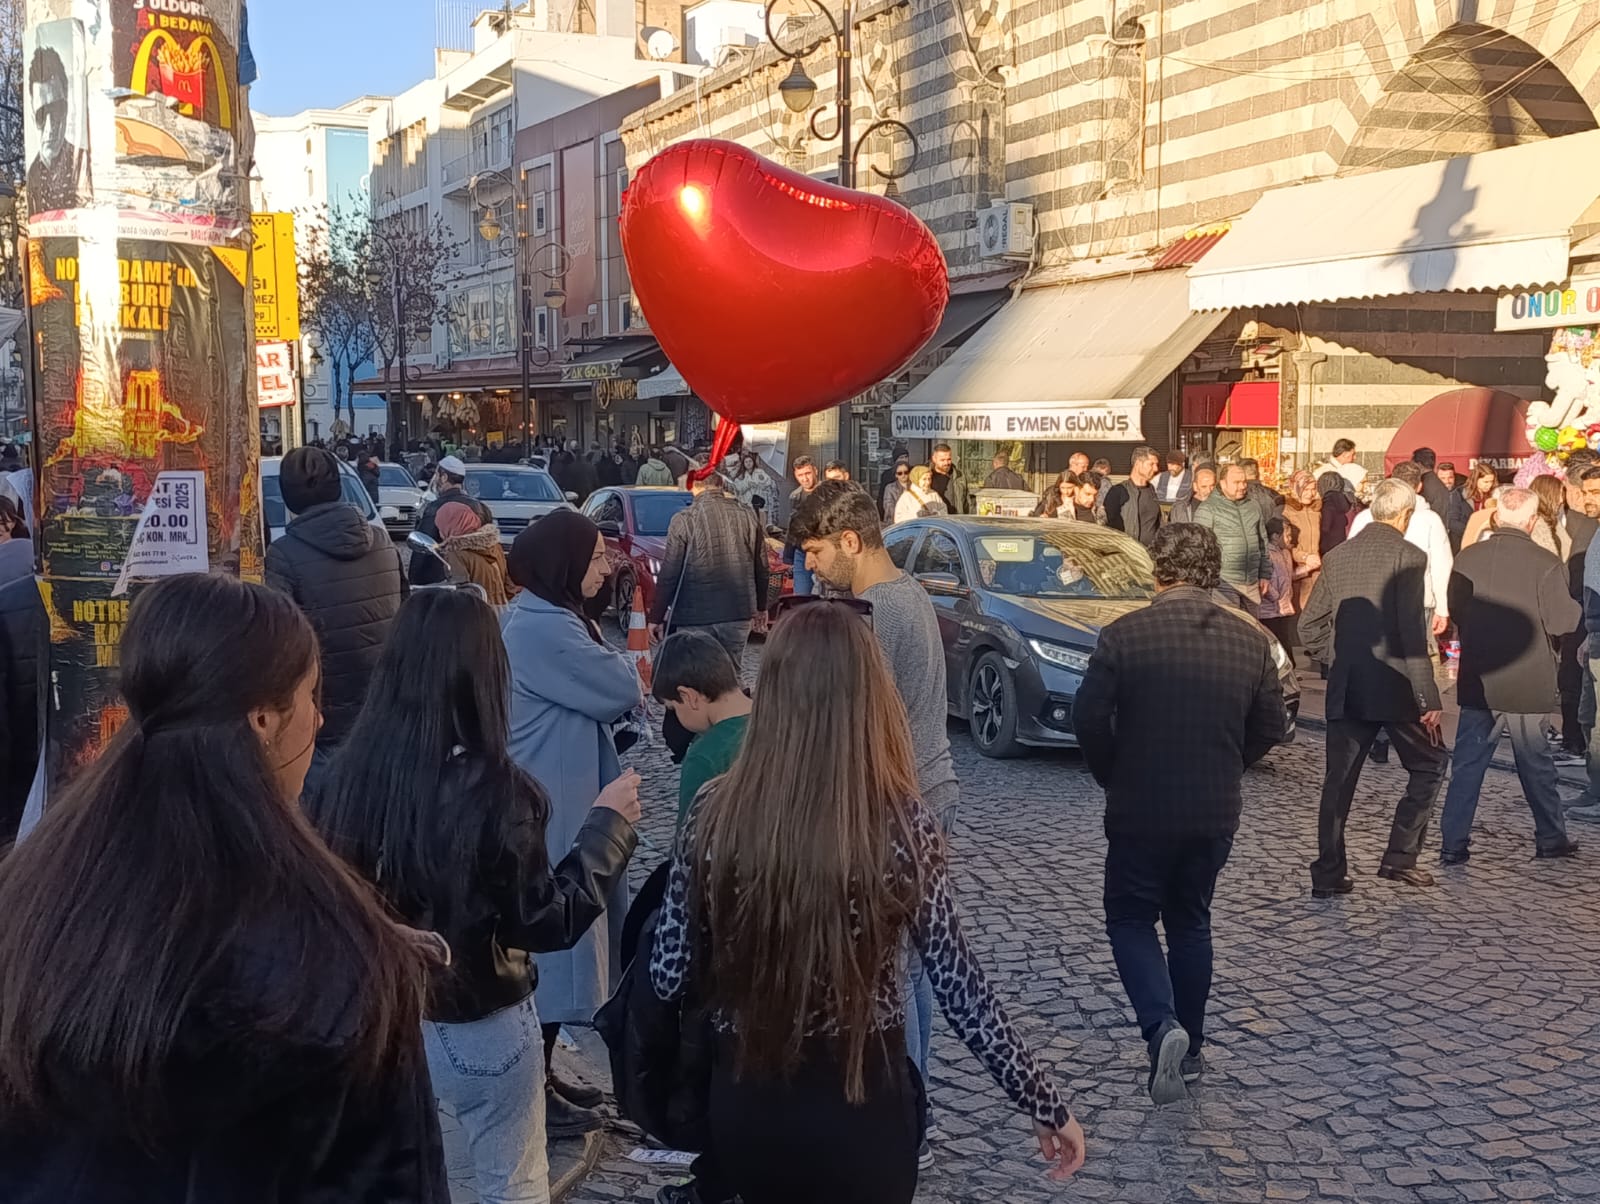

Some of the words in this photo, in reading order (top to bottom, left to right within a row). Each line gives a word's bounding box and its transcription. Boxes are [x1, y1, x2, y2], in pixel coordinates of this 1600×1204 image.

[148, 13, 156, 26] 1
[159, 14, 213, 34] BEDAVA
[1511, 289, 1577, 320] ONUR
[584, 364, 608, 378] GOLD
[261, 375, 288, 391] EL
[895, 412, 952, 435] ÇAVUŞOĞLU
[956, 415, 991, 436] ÇANTA
[1006, 416, 1060, 432] EYMEN
[1065, 411, 1130, 436] GÜMÜŞ
[155, 494, 172, 508] ESİ
[175, 482, 189, 509] 2025
[143, 514, 188, 528] 20.00
[72, 600, 130, 622] NOTRE
